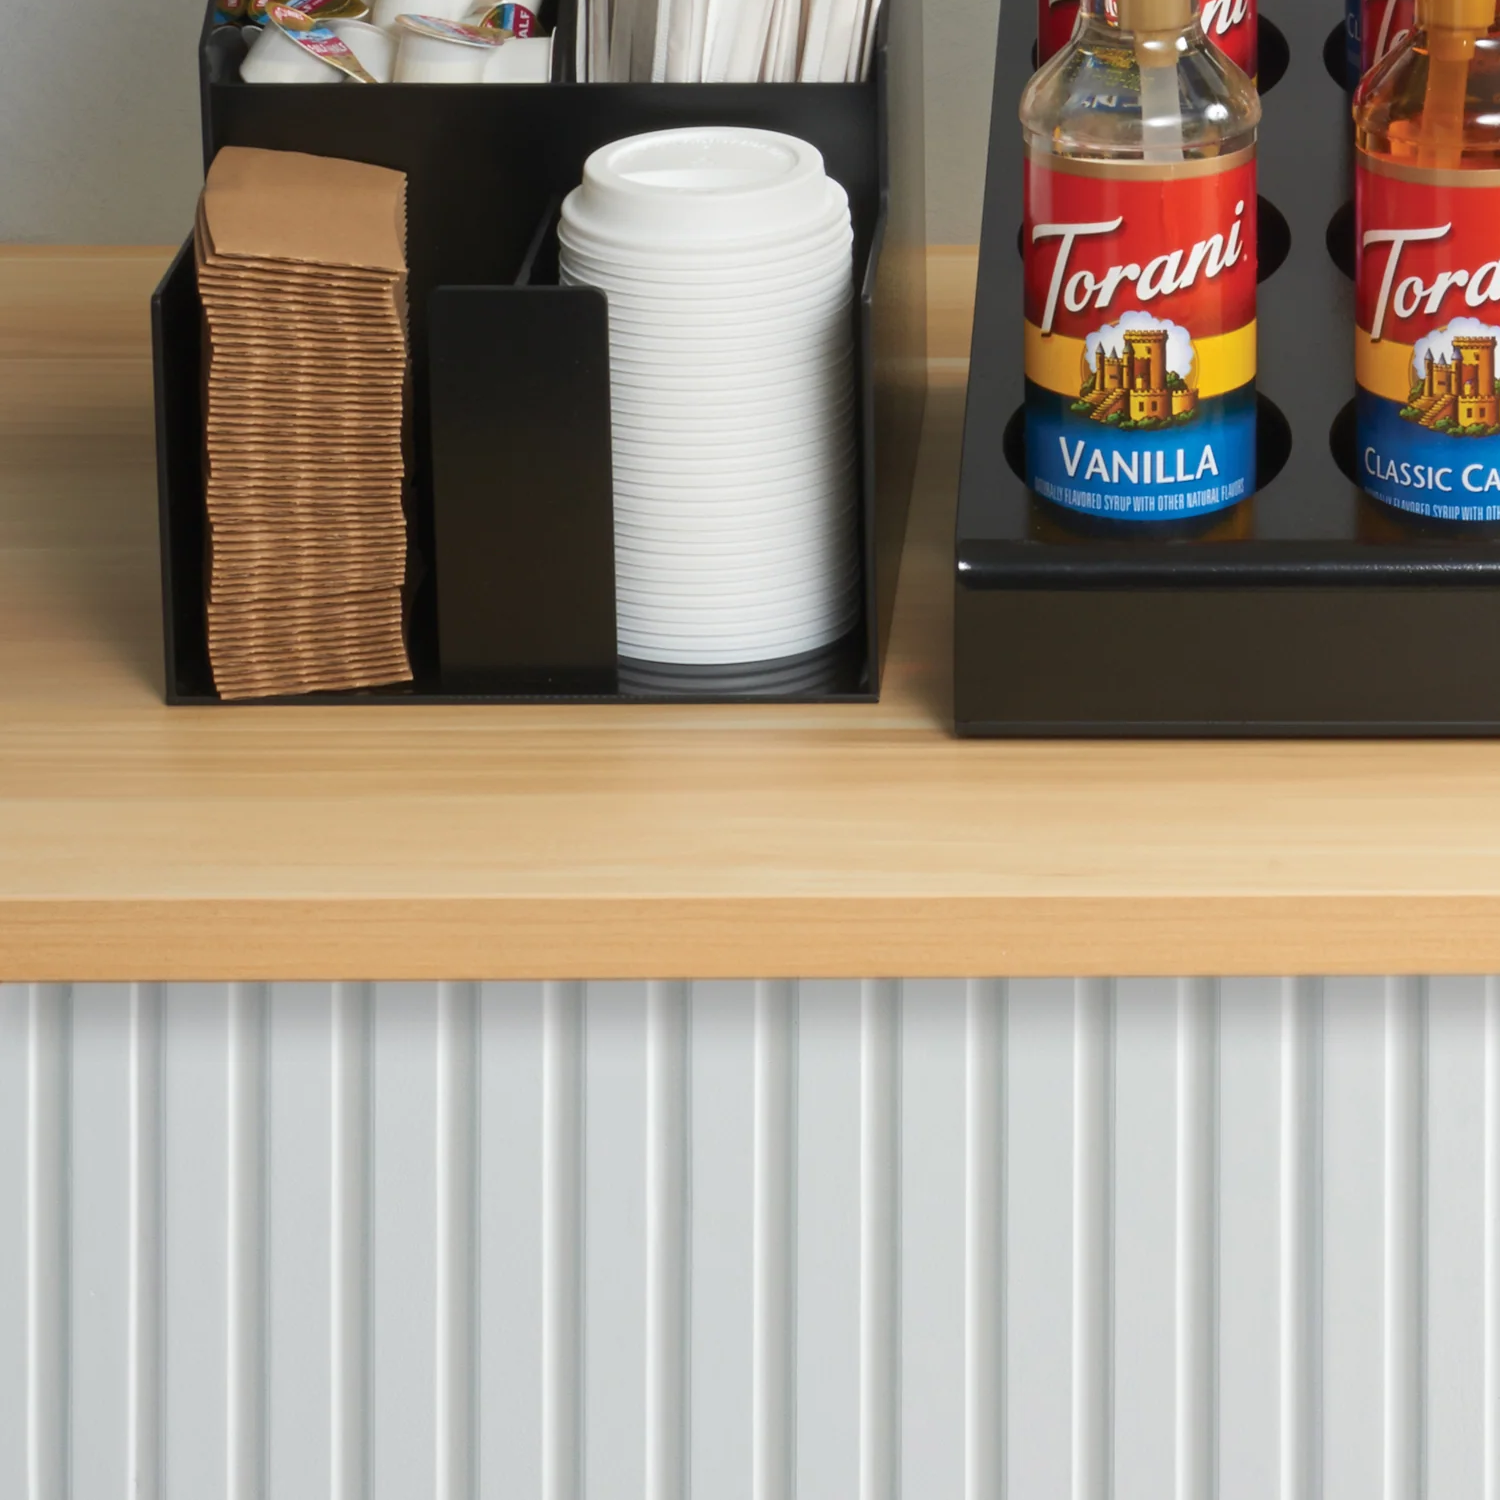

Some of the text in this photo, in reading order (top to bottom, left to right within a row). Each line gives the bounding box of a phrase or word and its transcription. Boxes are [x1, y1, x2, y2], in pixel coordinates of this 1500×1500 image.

[518, 10, 530, 39] ALF
[1032, 200, 1245, 334] Torani
[1059, 436, 1219, 484] VANILLA
[1364, 447, 1453, 491] CLASSIC
[1064, 487, 1102, 510] FLAVORED
[1104, 494, 1132, 512] SYRUP
[1133, 496, 1155, 512] WITH
[1157, 493, 1184, 512] OTHER
[1186, 486, 1219, 509] NATURAL
[1221, 477, 1245, 502] FLAVORS
[1432, 504, 1460, 521] SYRUP
[1461, 505, 1484, 521] WITH
